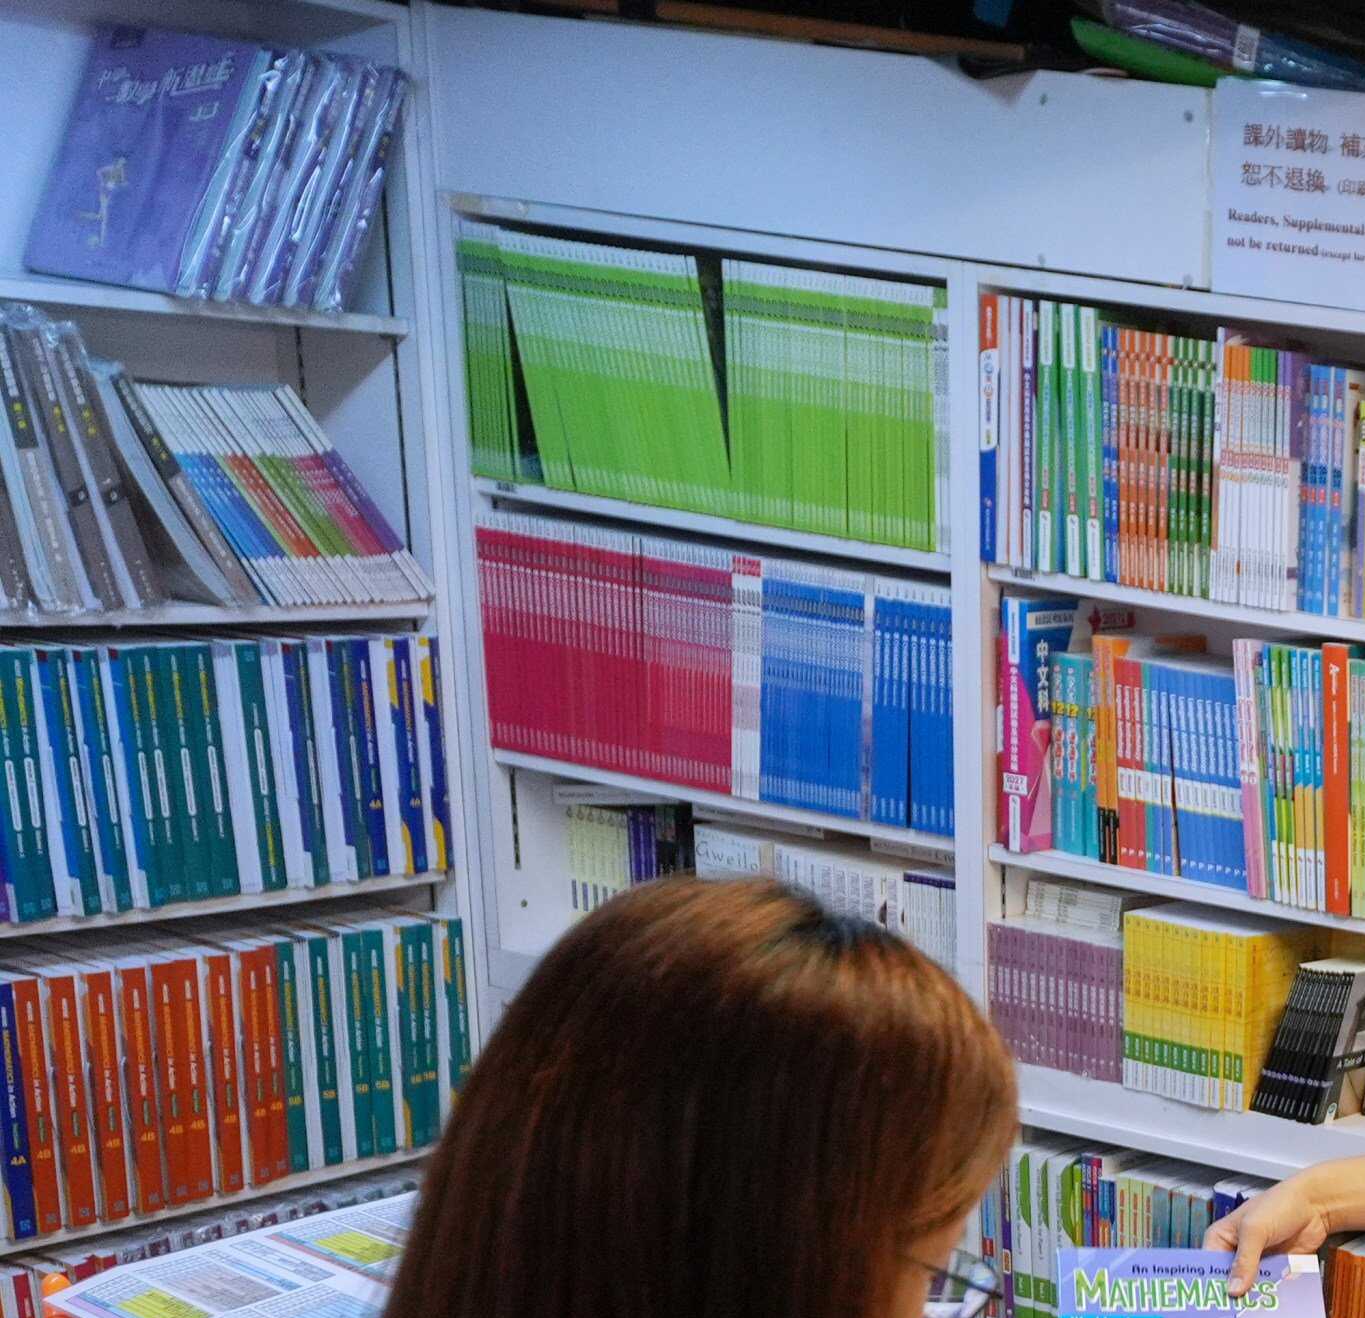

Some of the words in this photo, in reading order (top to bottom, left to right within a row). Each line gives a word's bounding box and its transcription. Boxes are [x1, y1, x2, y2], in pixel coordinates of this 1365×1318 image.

[1242, 123, 1328, 155] 課外讀物
[1240, 160, 1327, 193] 恕不退換
[1227, 208, 1279, 226] Readers,
[1281, 214, 1365, 237] Supplemental
[1227, 236, 1245, 247] not
[1249, 237, 1262, 248] be
[1266, 239, 1318, 255] returned
[696, 840, 758, 871] Gweilo
[11, 1155, 26, 1166] 4A
[1132, 1264, 1149, 1274] An
[1153, 1264, 1205, 1278] Inspiring
